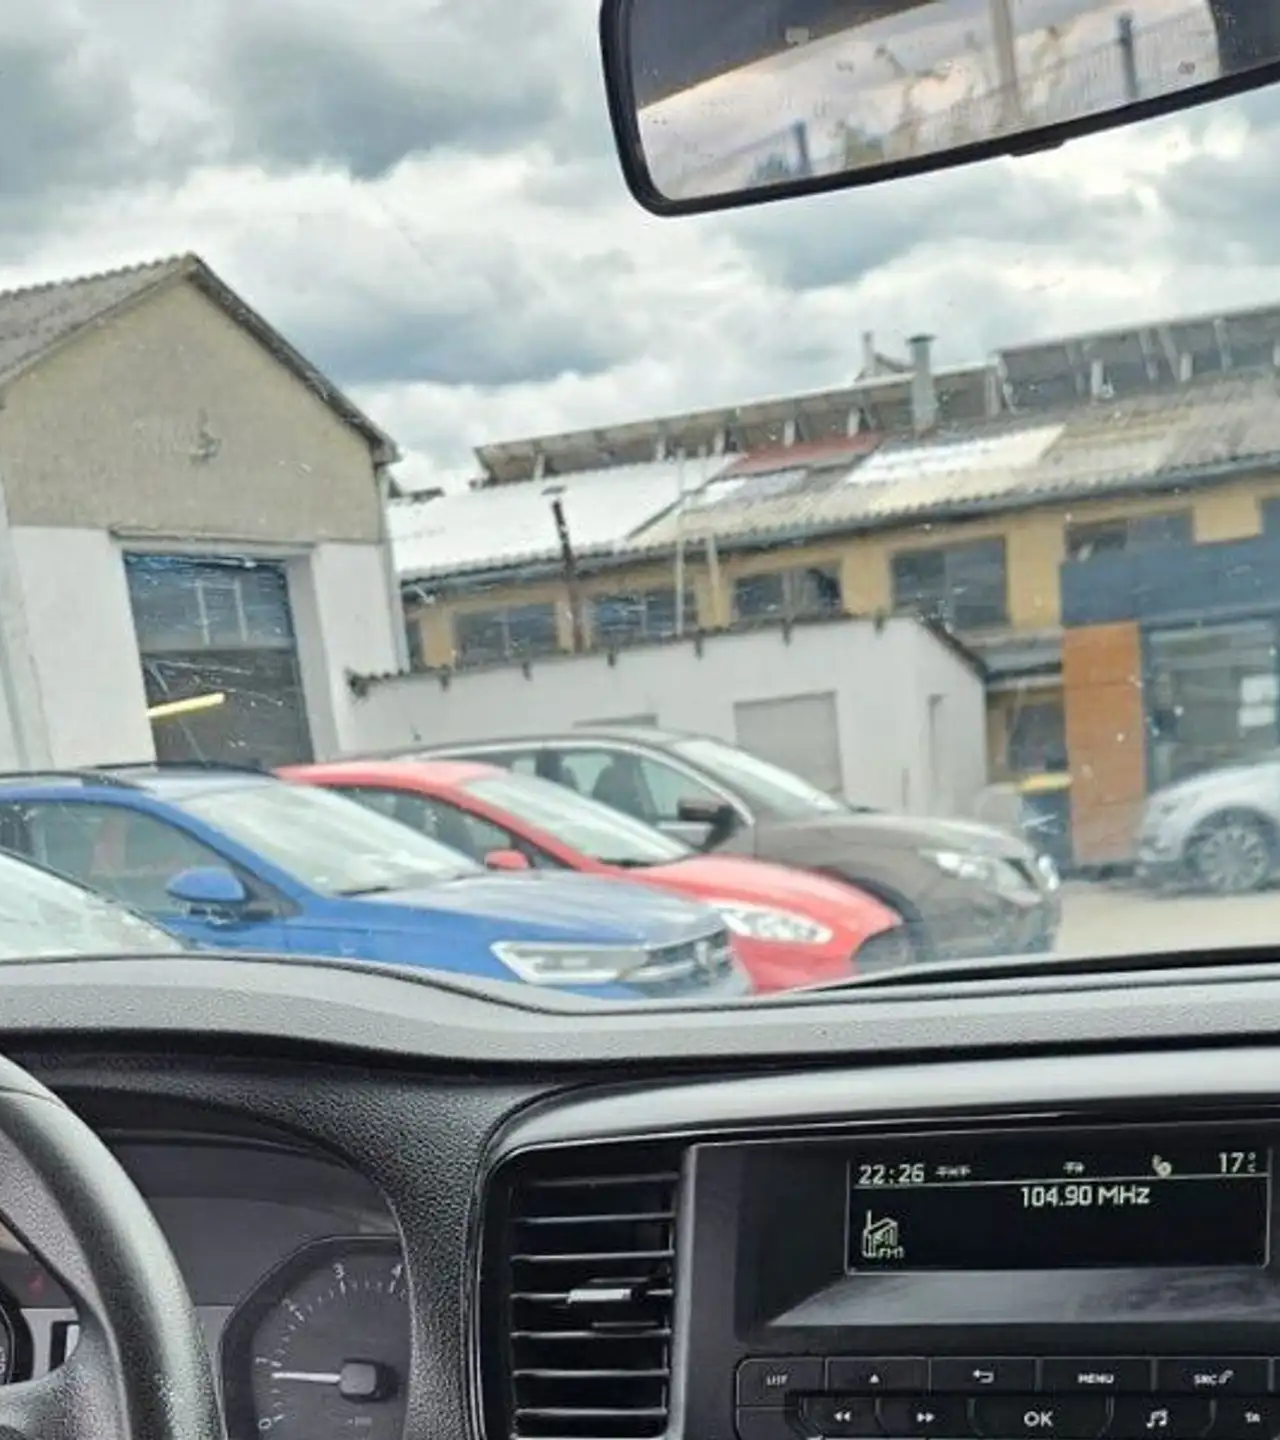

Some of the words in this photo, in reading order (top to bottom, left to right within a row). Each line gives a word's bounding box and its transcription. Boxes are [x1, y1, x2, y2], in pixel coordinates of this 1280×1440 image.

[858, 1163, 925, 1185] 22:26
[1021, 1185, 1094, 1208] 104.90
[1098, 1185, 1151, 1206] MHz
[1077, 1372, 1115, 1385] MENU
[1023, 1410, 1054, 1427] OK
